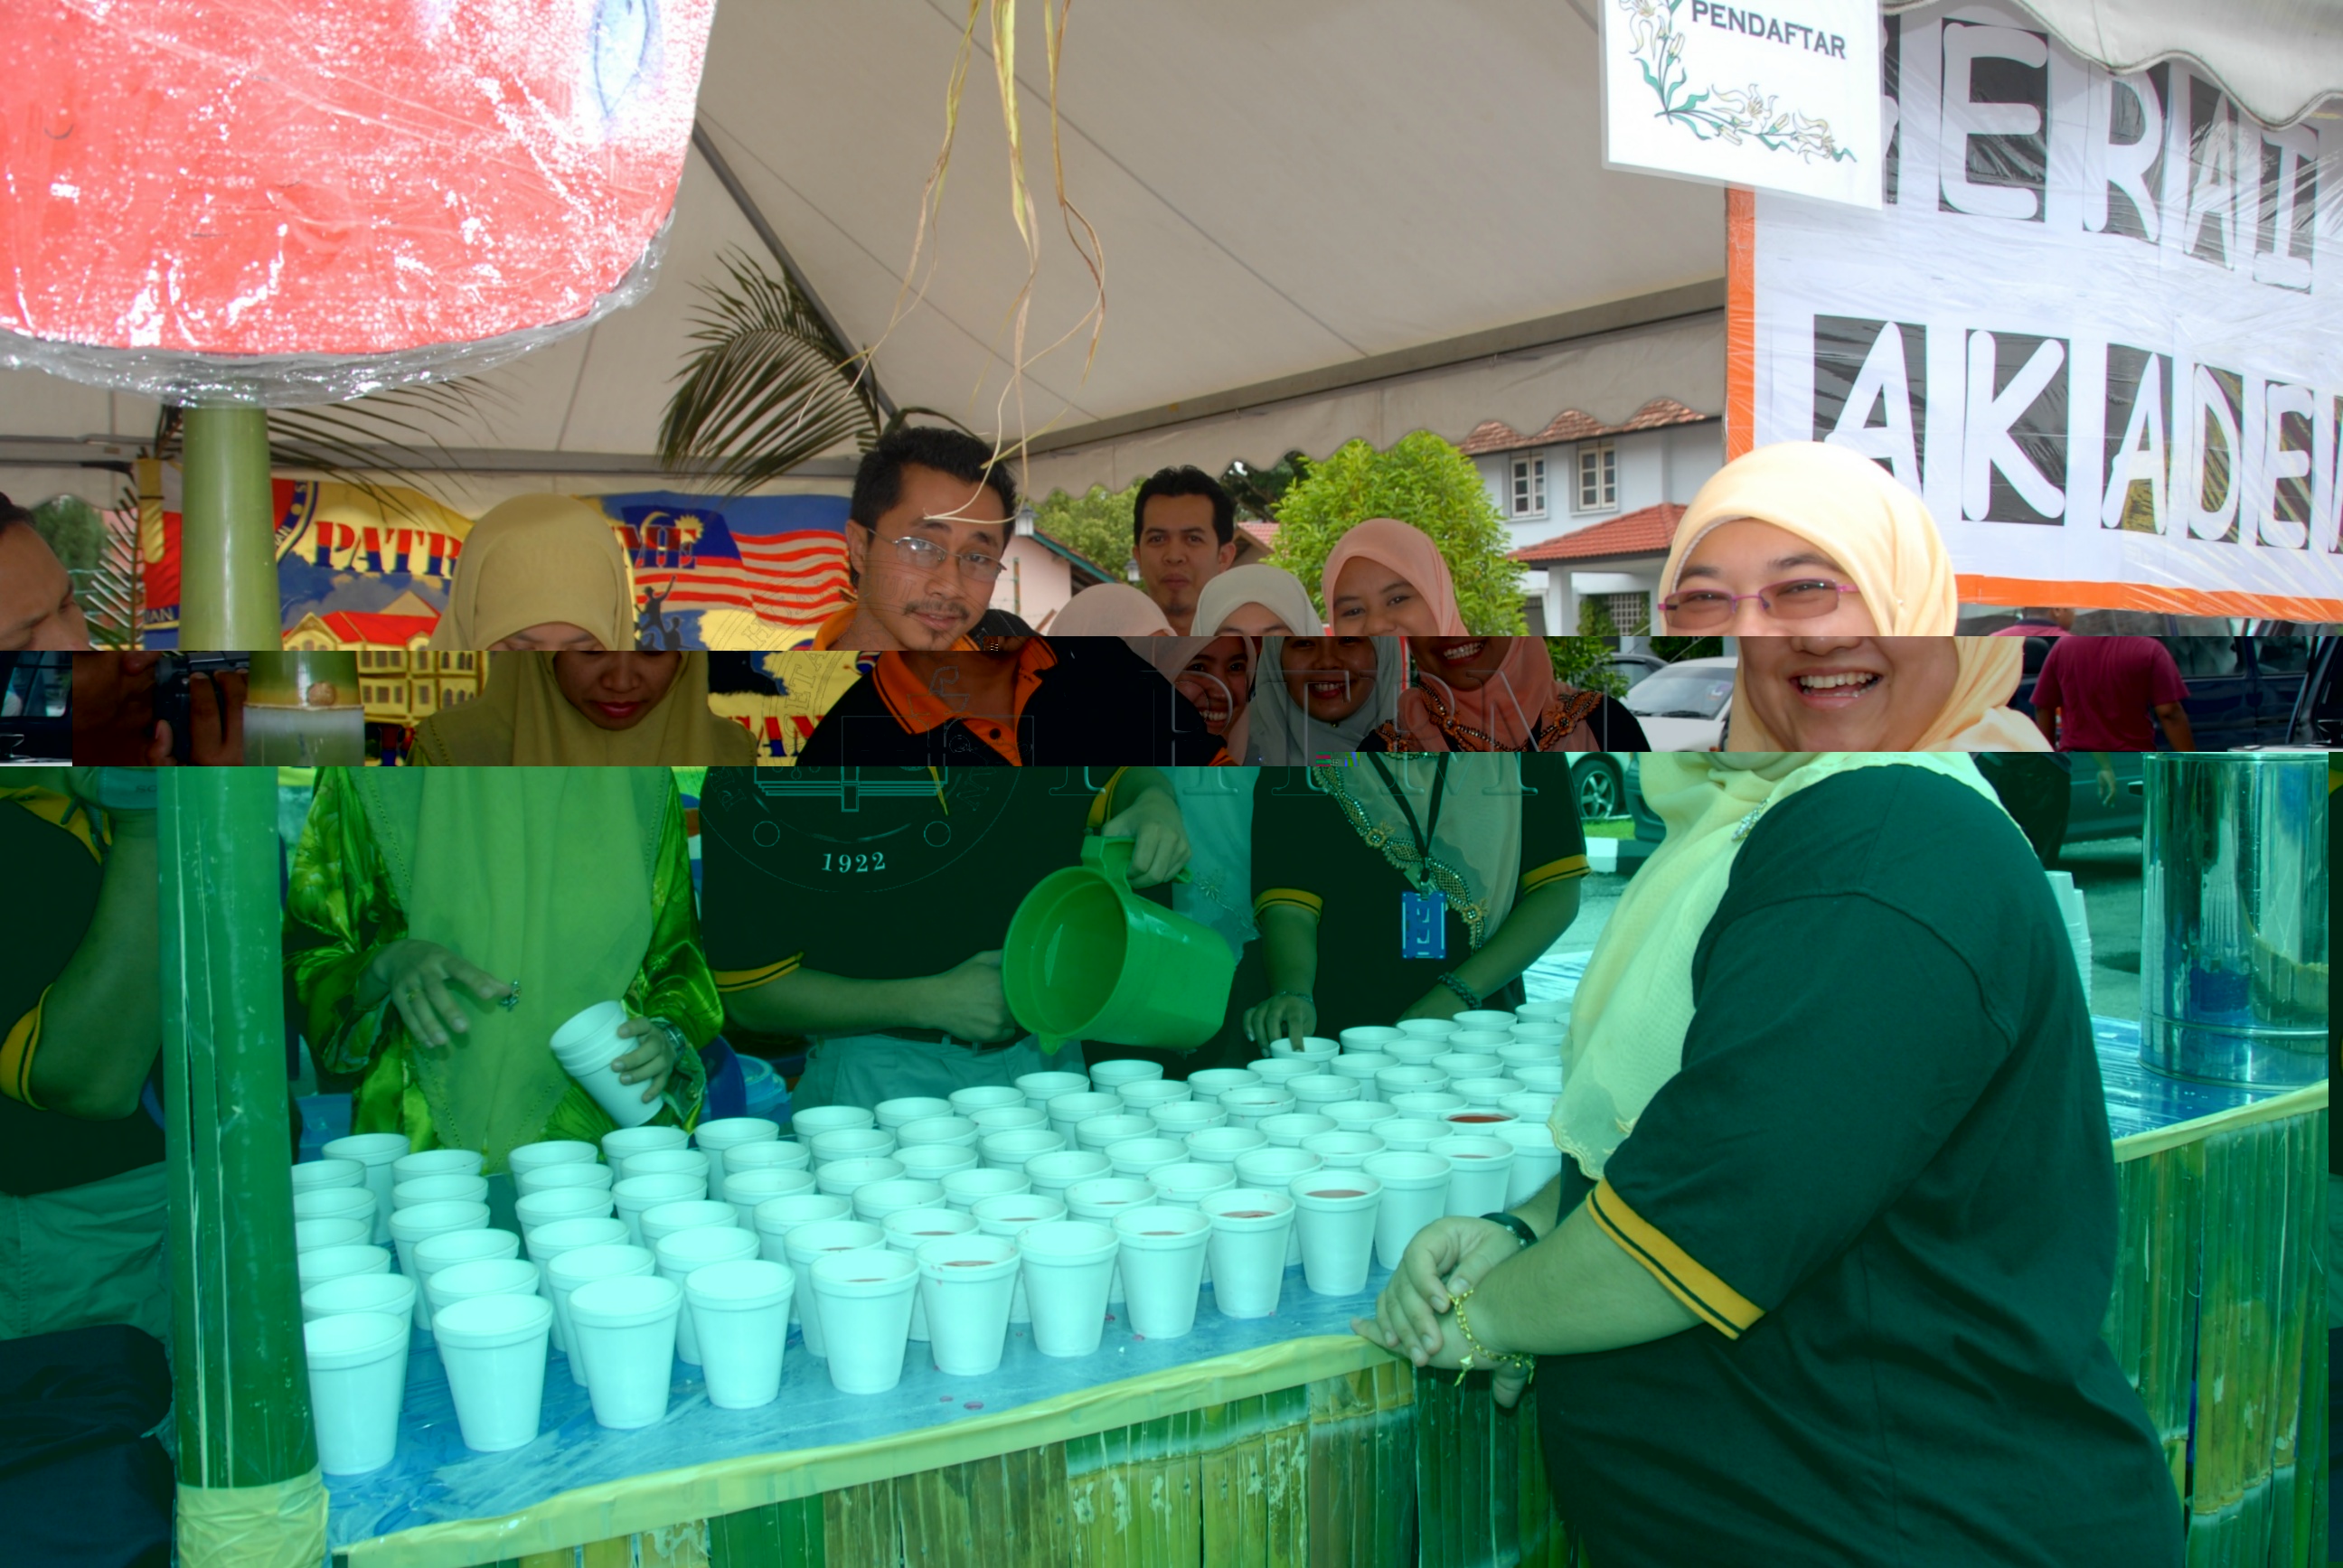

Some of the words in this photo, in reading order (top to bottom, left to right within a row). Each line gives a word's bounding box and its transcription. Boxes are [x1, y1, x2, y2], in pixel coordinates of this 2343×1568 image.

[1691, 0, 1847, 60] PENDAFTAR
[1883, 22, 2318, 290] ERAI
[1822, 321, 2343, 552] AKADE
[313, 521, 463, 577] PATR
